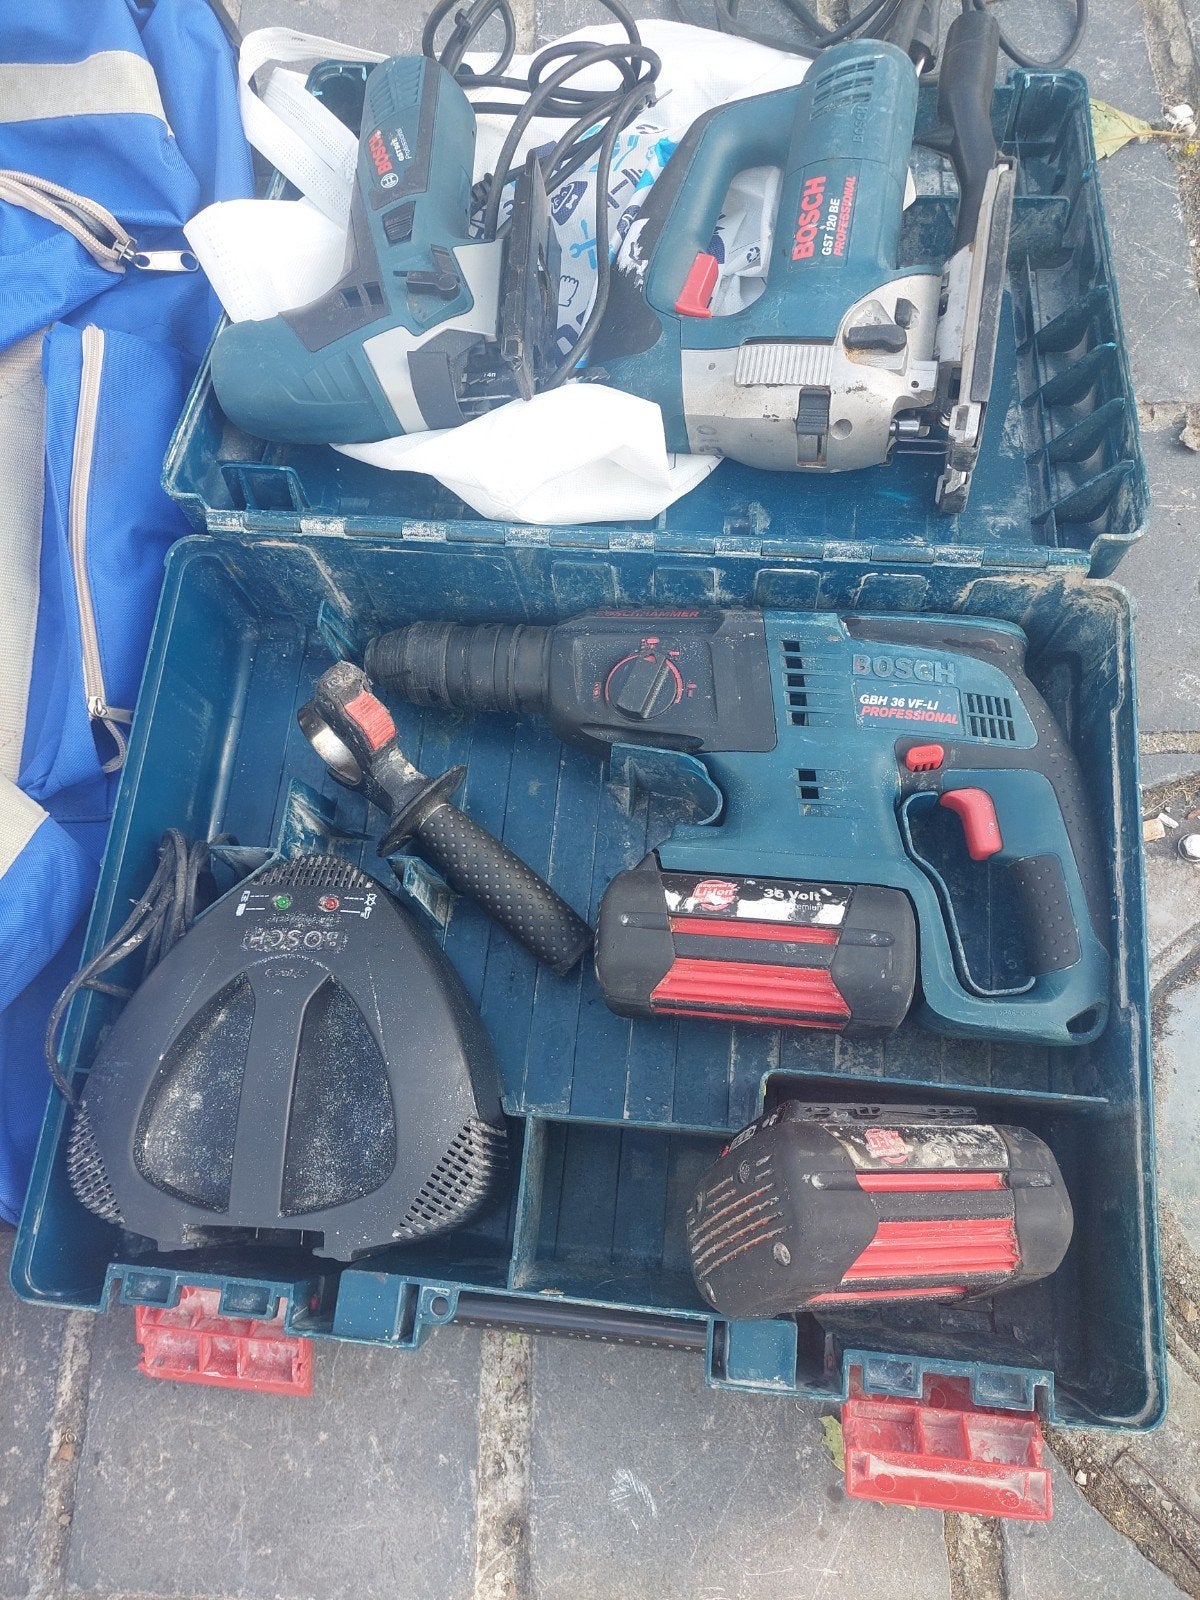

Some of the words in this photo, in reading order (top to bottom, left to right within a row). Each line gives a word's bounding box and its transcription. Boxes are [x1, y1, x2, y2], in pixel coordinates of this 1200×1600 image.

[368, 130, 392, 175] BOSCH
[829, 198, 841, 214] BE
[833, 176, 857, 256] PROFESSIONAL
[792, 176, 827, 260] BOSCH
[826, 215, 838, 231] 120
[821, 233, 834, 256] GST
[852, 653, 957, 685] BOSCH
[860, 694, 888, 706] GBH
[890, 697, 906, 708] 36
[908, 698, 939, 711] VF-LI
[861, 705, 959, 725] PROFESSIONAL
[763, 888, 785, 899] 36
[787, 889, 822, 903] Volt
[249, 929, 340, 950] BOSCH
